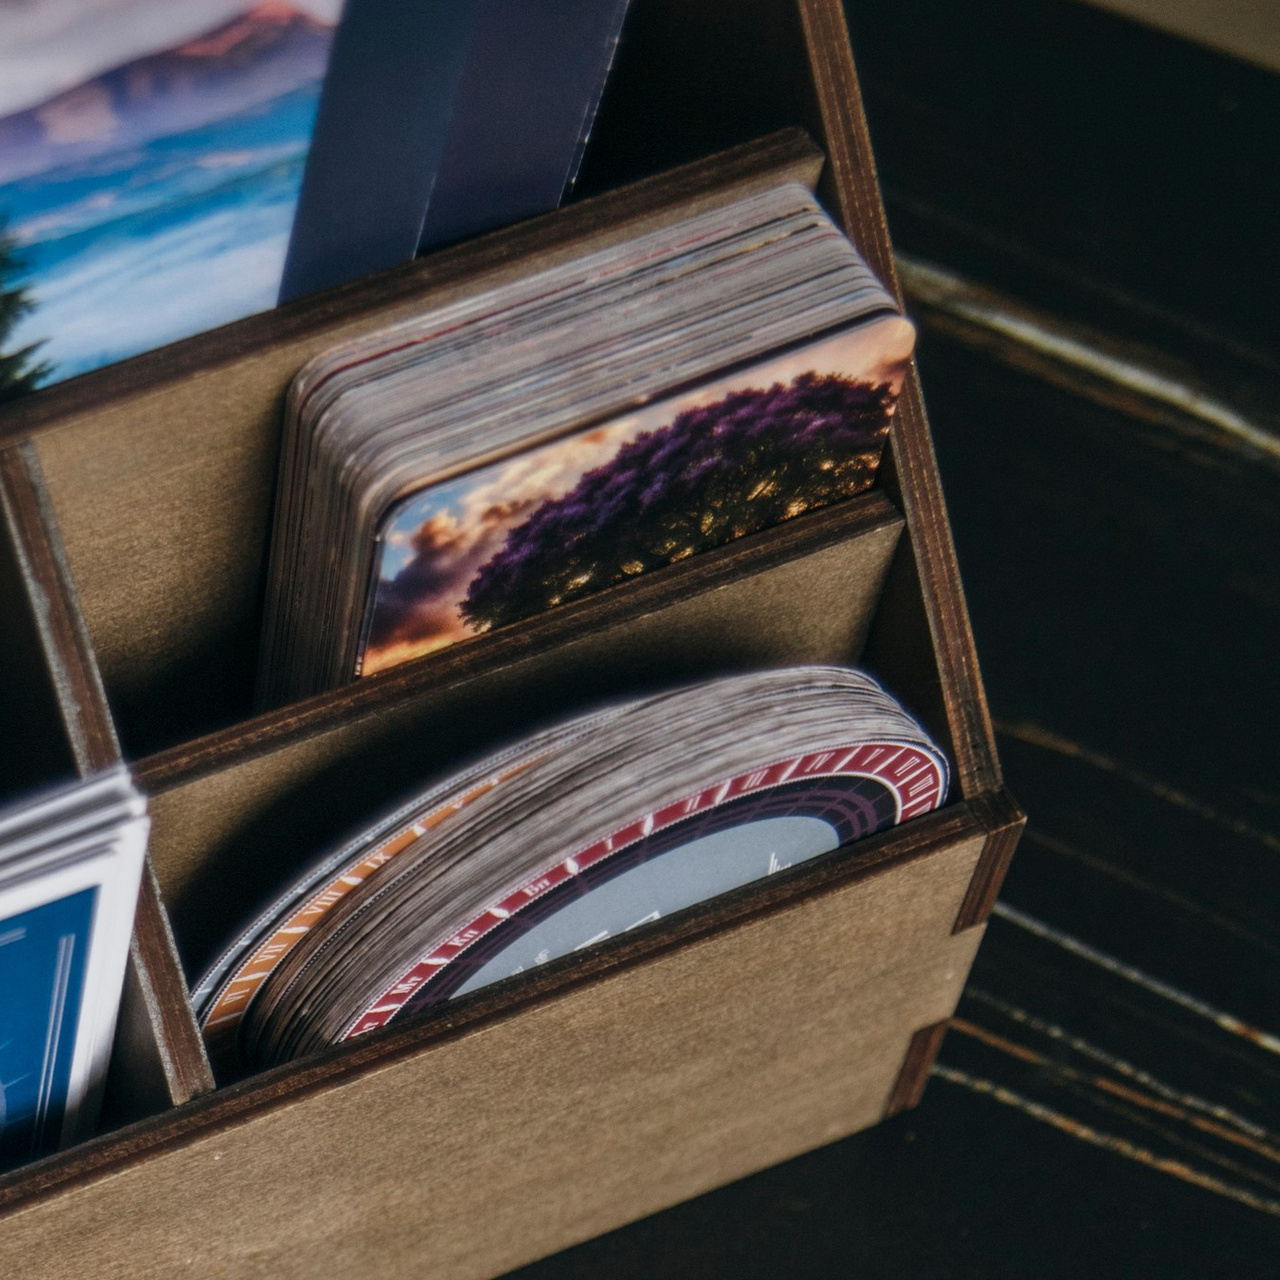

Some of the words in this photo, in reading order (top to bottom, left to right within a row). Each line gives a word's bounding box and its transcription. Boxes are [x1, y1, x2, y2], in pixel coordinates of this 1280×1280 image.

[685, 795, 701, 813] II
[742, 769, 770, 789] III
[805, 752, 837, 773] IV
[861, 748, 885, 767] V
[894, 756, 921, 777] VI
[909, 773, 934, 797] VII
[253, 942, 288, 965] VII
[303, 891, 344, 916] VIII
[365, 853, 391, 870] IX
